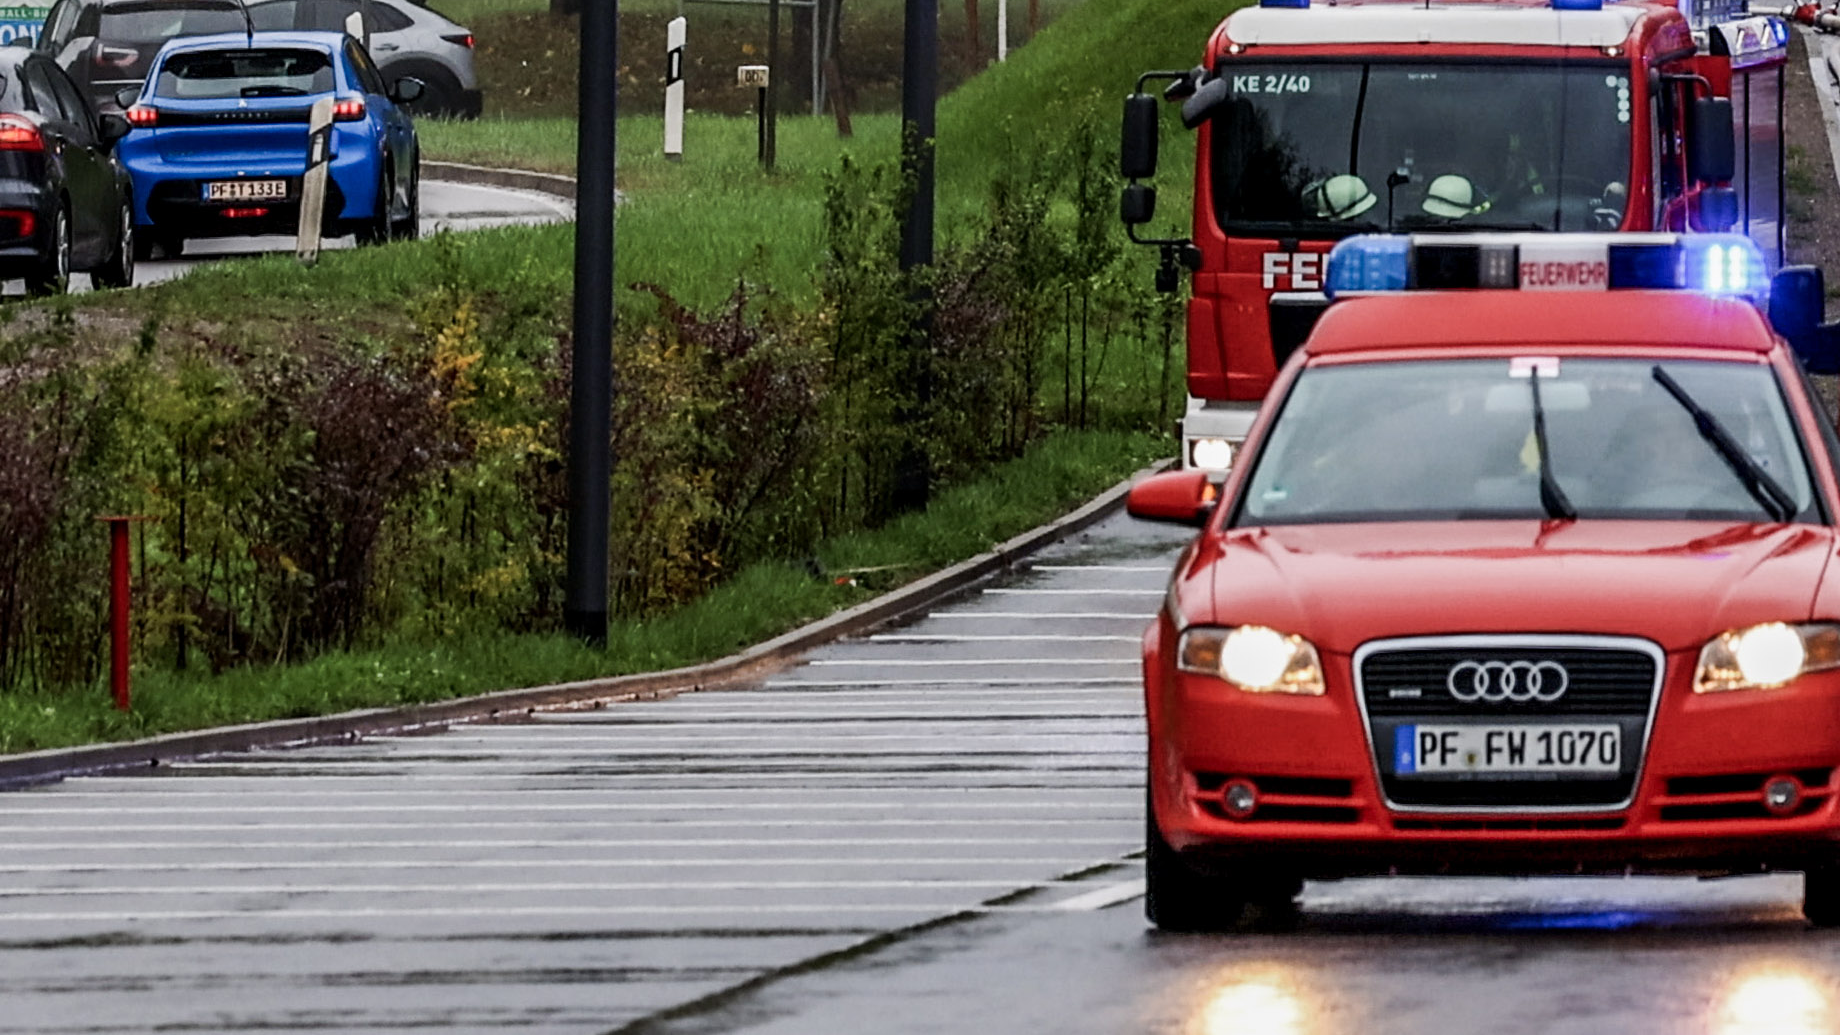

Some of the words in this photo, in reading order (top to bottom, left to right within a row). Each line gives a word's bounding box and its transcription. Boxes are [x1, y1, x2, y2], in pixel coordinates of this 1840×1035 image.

[1233, 75, 1260, 93] KE
[1265, 74, 1311, 94] 2/40
[211, 185, 228, 197] PF
[1521, 262, 1606, 285] FEUERWEHR
[1420, 731, 1459, 765] PF
[1486, 731, 1526, 765] FW
[1537, 731, 1617, 765] 1070
